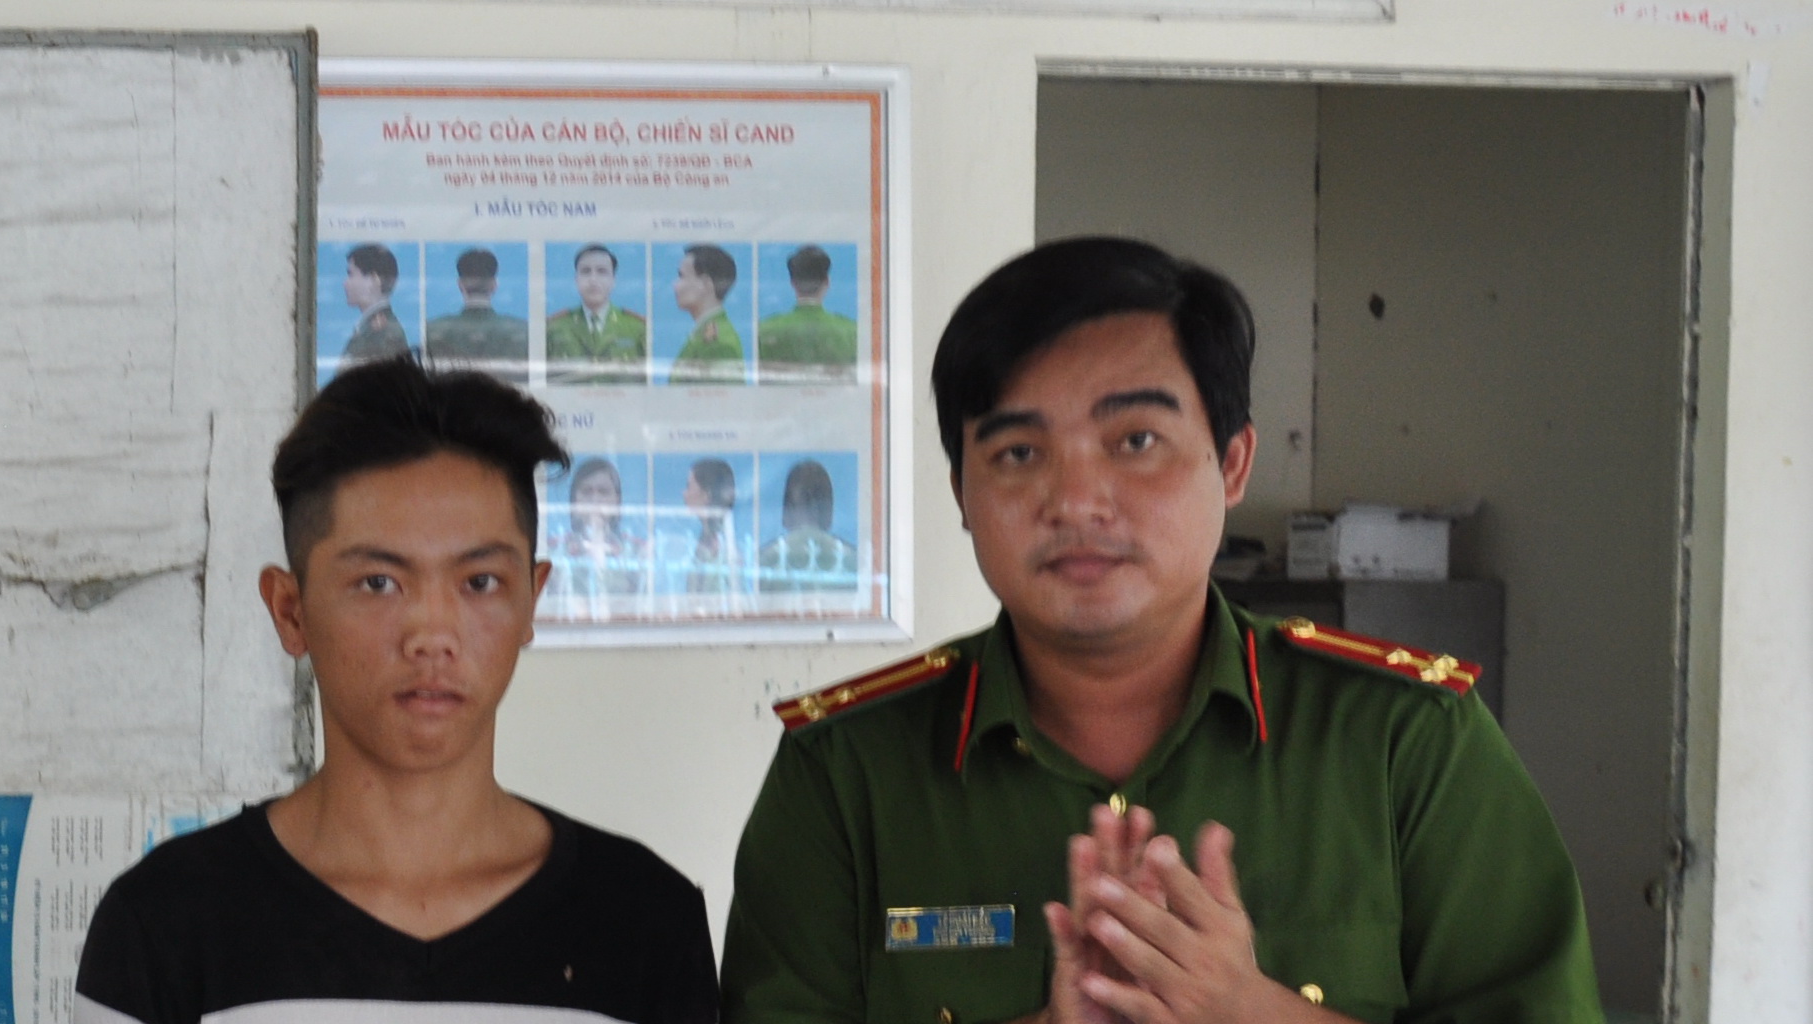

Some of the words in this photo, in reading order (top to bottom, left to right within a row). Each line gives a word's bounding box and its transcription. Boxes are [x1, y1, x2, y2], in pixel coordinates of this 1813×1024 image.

[382, 113, 430, 141] MẪU
[438, 118, 483, 141] TÓC
[490, 117, 535, 141] CỦA
[542, 117, 588, 142] CÁN
[637, 117, 703, 143] CHIẾN
[709, 118, 729, 144] SĨ
[736, 123, 795, 144] CAND
[487, 196, 522, 217] MẪU
[527, 200, 558, 217] TÓC
[562, 201, 597, 218] NAM
